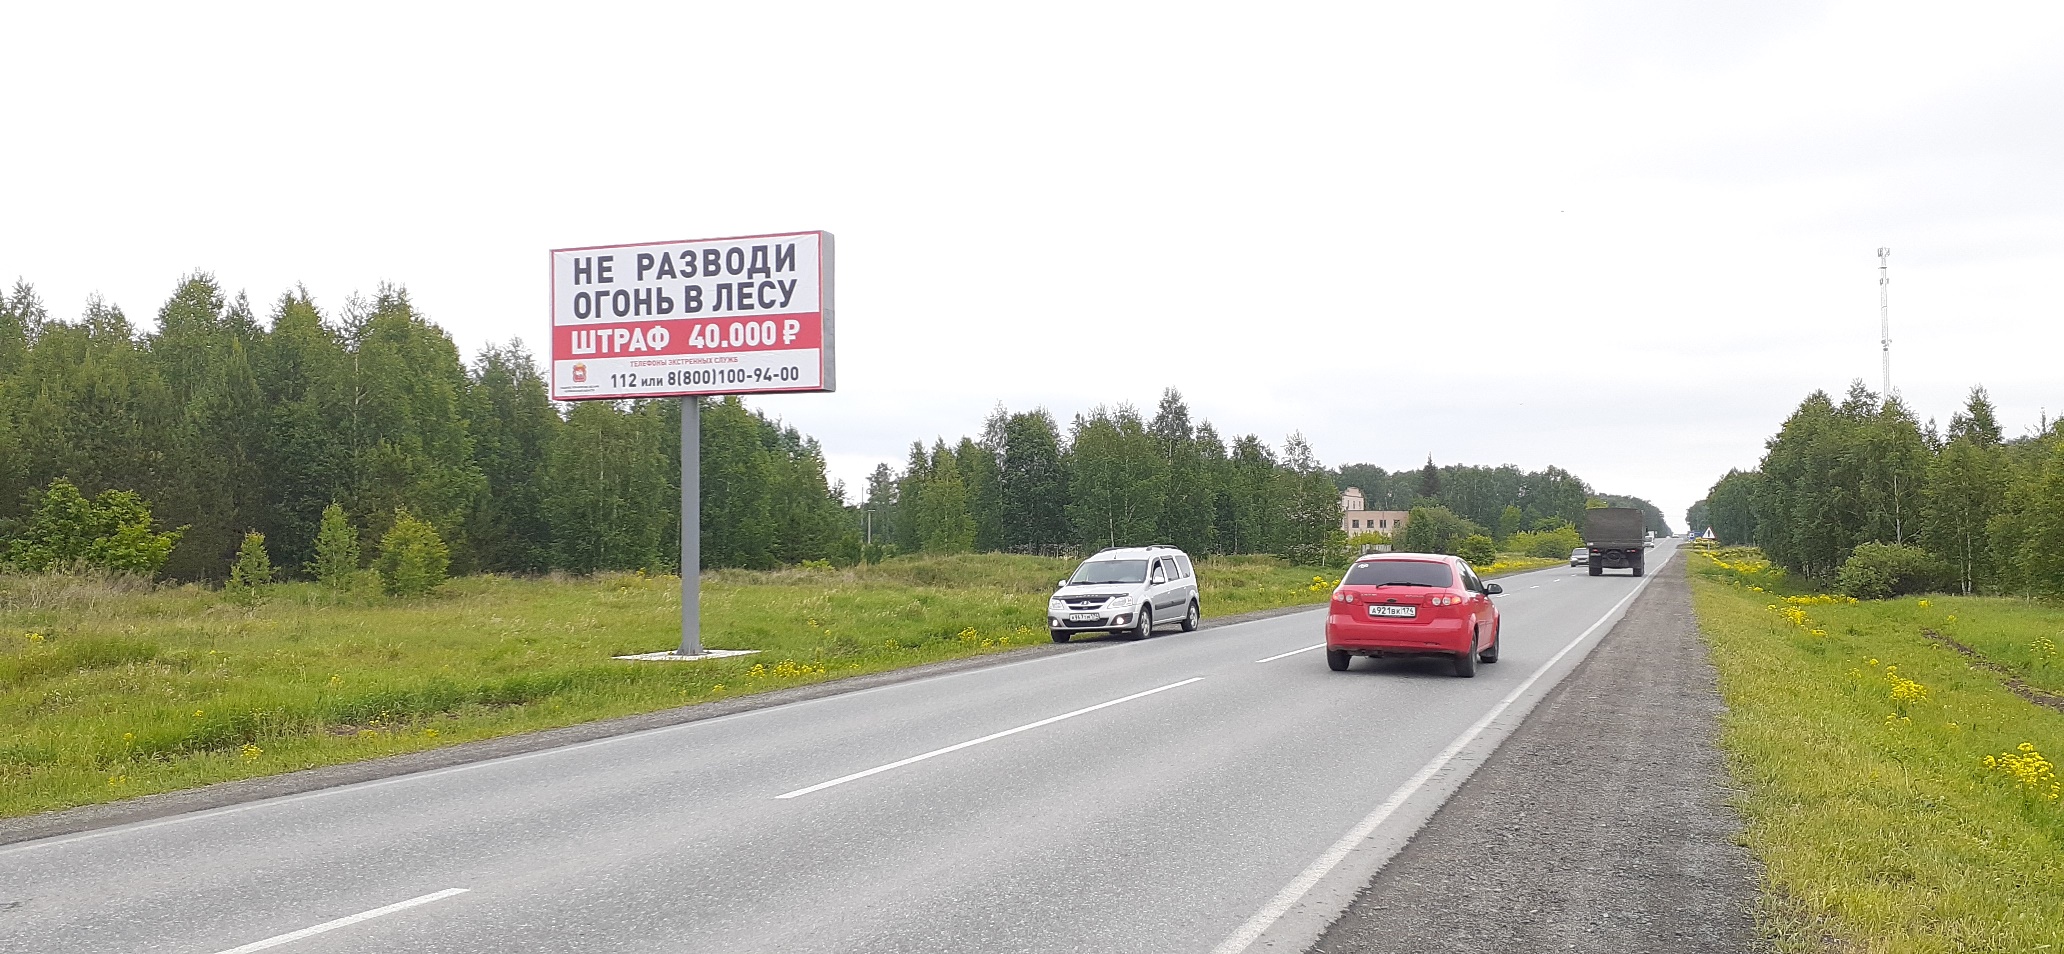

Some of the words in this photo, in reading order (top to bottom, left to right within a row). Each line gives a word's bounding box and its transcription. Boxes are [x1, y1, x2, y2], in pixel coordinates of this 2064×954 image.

[574, 255, 614, 285] НЕ
[637, 243, 796, 281] РАЗВОДИ
[574, 286, 675, 319] ОГОНЬ
[684, 284, 704, 313] В
[712, 278, 798, 312] ЛЕСУ
[571, 325, 670, 355] ШТРАФ
[688, 320, 777, 349] 40.000
[611, 373, 637, 388] 112
[641, 377, 664, 387] или
[667, 366, 800, 387] 8(800)100-94-00
[630, 359, 667, 368] ТЕЛЕФОНЫ
[668, 357, 713, 366] ЭКСТРЕННЫХ
[714, 356, 738, 364] СЛУЖБ
